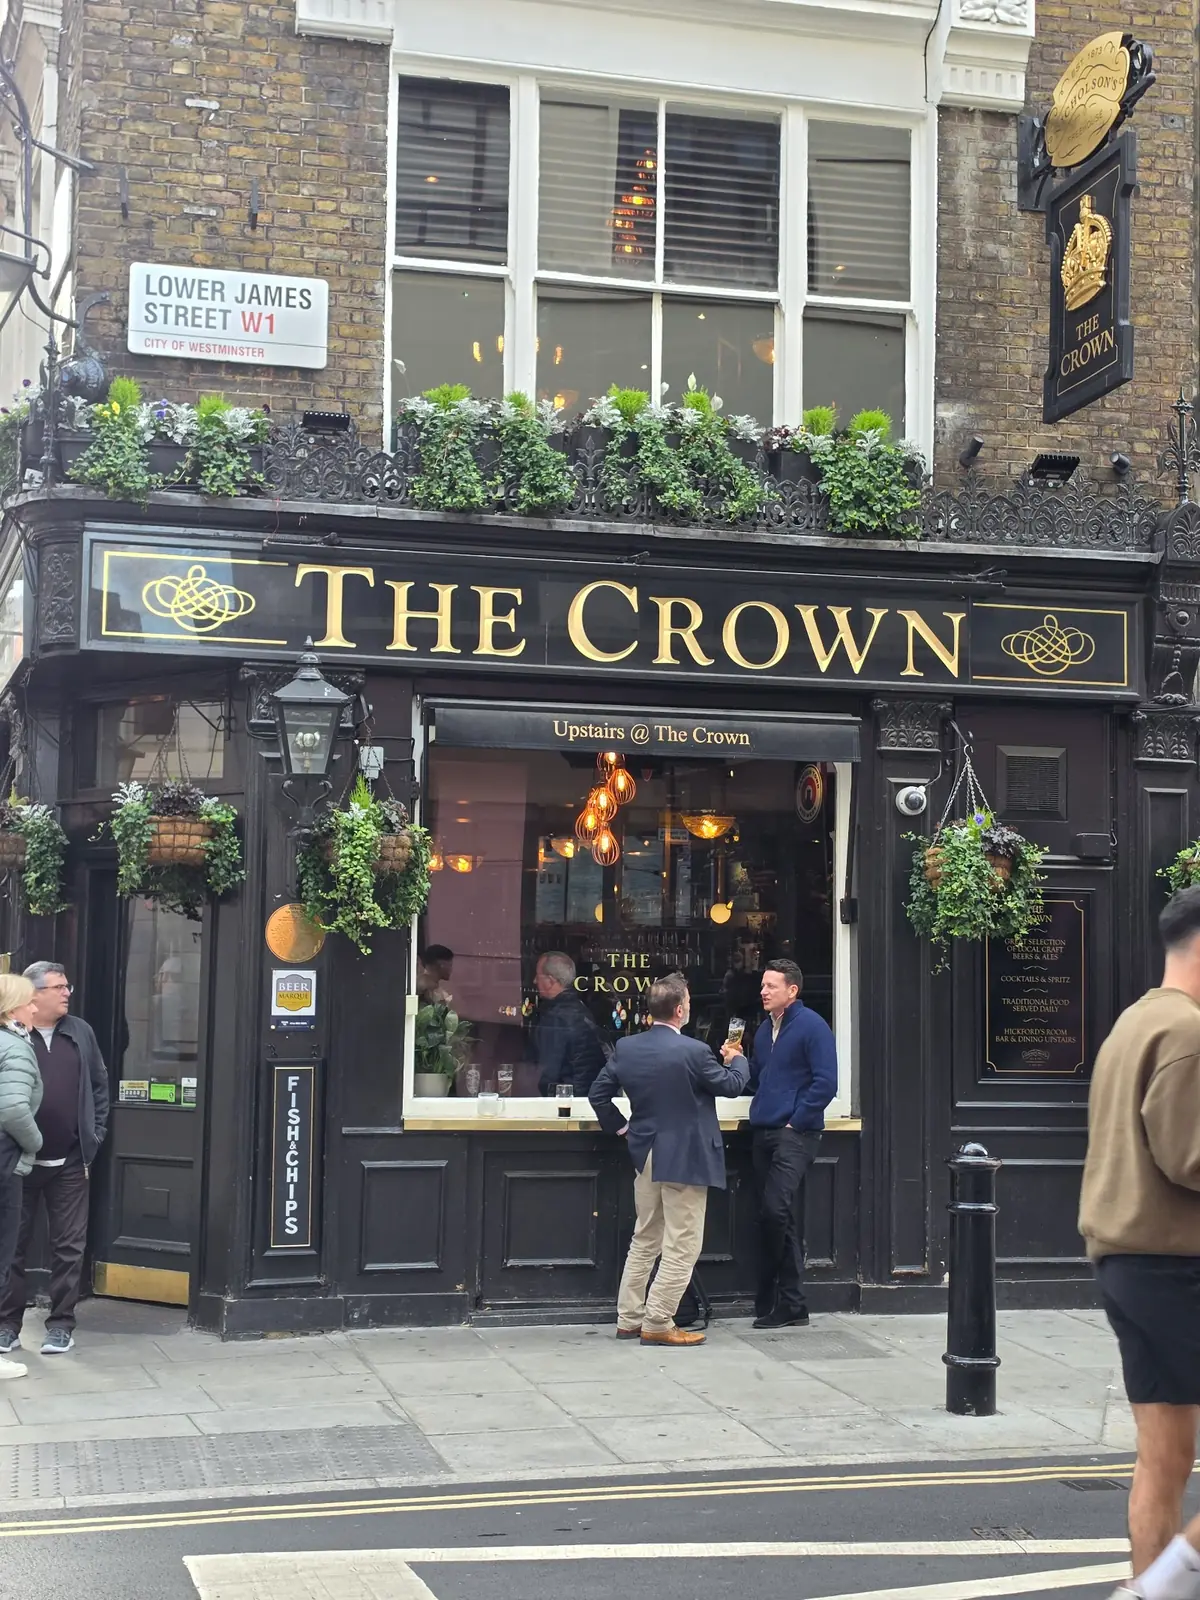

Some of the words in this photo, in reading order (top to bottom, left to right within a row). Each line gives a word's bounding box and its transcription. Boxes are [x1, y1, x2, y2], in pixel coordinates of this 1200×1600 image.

[1087, 46, 1103, 59] 1873
[1055, 76, 1118, 125] CHOLSON'S
[145, 274, 225, 302] LOWER
[234, 282, 312, 310] JAMES
[144, 302, 232, 331] STREET
[241, 311, 275, 335] W1
[1075, 313, 1100, 341] THE
[144, 337, 168, 349] CITY
[172, 340, 185, 351] OF
[189, 341, 265, 358] WESTMINSTER
[1060, 326, 1114, 376] CROWN
[295, 563, 526, 657] THE
[567, 580, 967, 678] CROWN
[553, 720, 625, 742] Upstairs
[630, 723, 650, 745] @
[654, 725, 688, 742] The
[692, 727, 750, 745] Crown
[1028, 938, 1066, 946] SELECTION
[1006, 945, 1016, 953] OF
[1041, 946, 1064, 954] CRAFT
[607, 953, 651, 968] THE
[1042, 953, 1059, 961] ALES
[573, 976, 658, 993] CROW
[1000, 975, 1040, 983] COCKTAILS
[278, 982, 309, 992] BEER
[278, 992, 309, 1001] MARQUE
[1002, 998, 1049, 1006] TRADITIONAL
[1039, 1005, 1060, 1013] DAILY
[1046, 1028, 1068, 1036] ROOM
[995, 1035, 1010, 1043] BAR
[1010, 1035, 1017, 1043] &
[1018, 1035, 1044, 1043] DINING
[1044, 1036, 1077, 1044] UPSTAIRS
